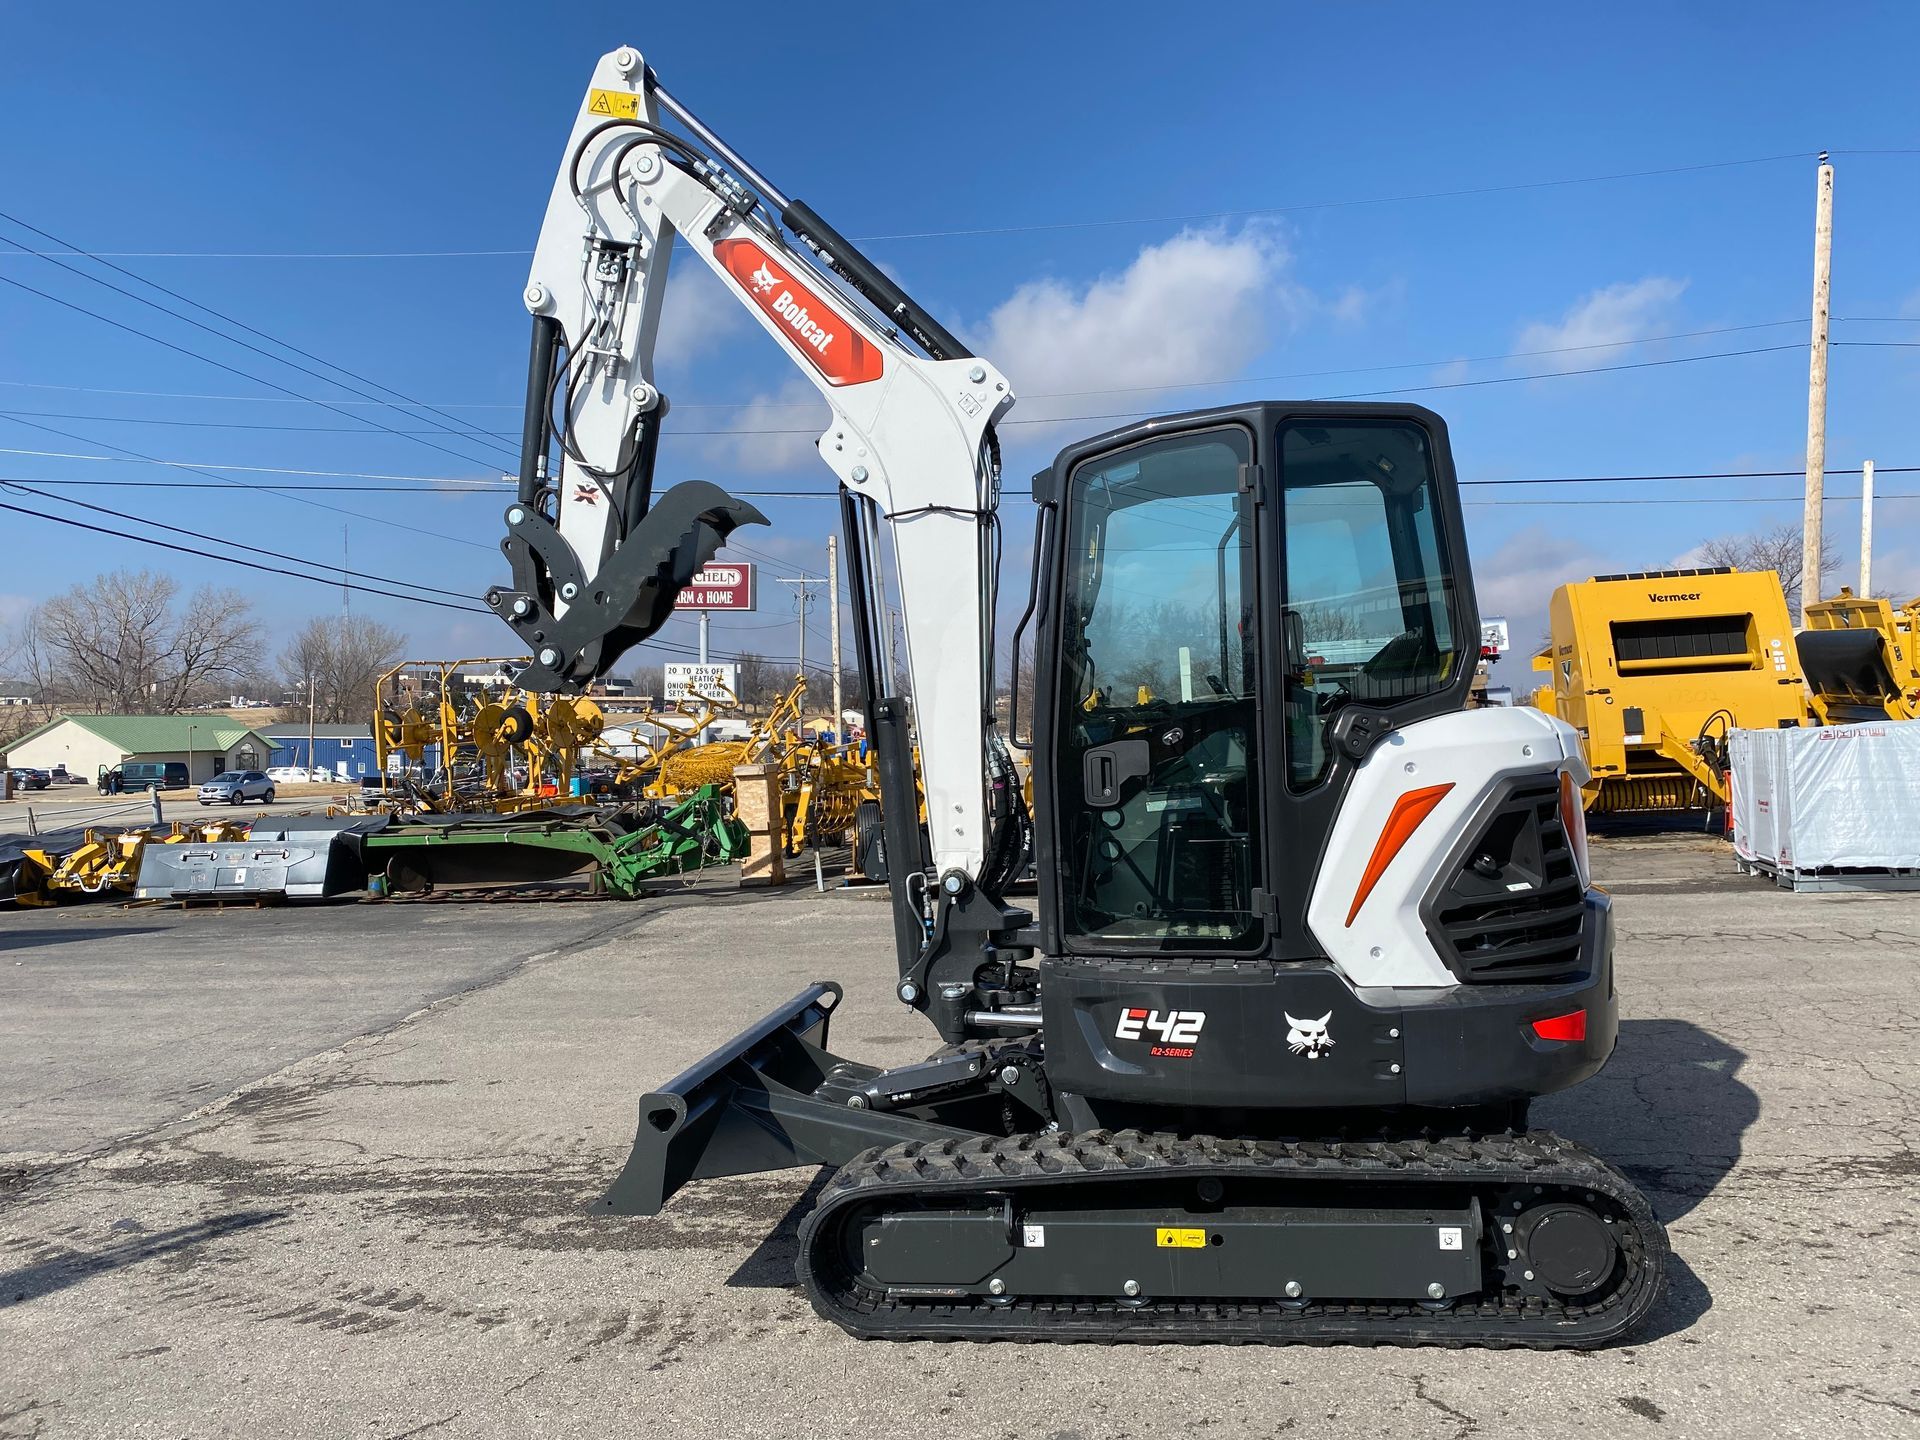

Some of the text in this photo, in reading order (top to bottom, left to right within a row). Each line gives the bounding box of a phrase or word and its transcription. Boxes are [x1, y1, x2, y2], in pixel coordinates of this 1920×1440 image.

[771, 290, 834, 353] Bobcat
[696, 592, 704, 604] &
[706, 591, 734, 604] HOME
[1647, 593, 1701, 603] Vermeer
[668, 667, 677, 675] 20
[683, 667, 691, 675] TO
[695, 667, 709, 675] 25%
[707, 690, 725, 698] HERE
[388, 763, 399, 772] 25
[1115, 1008, 1206, 1043] E42
[1150, 1047, 1194, 1058] R2-SERIES
